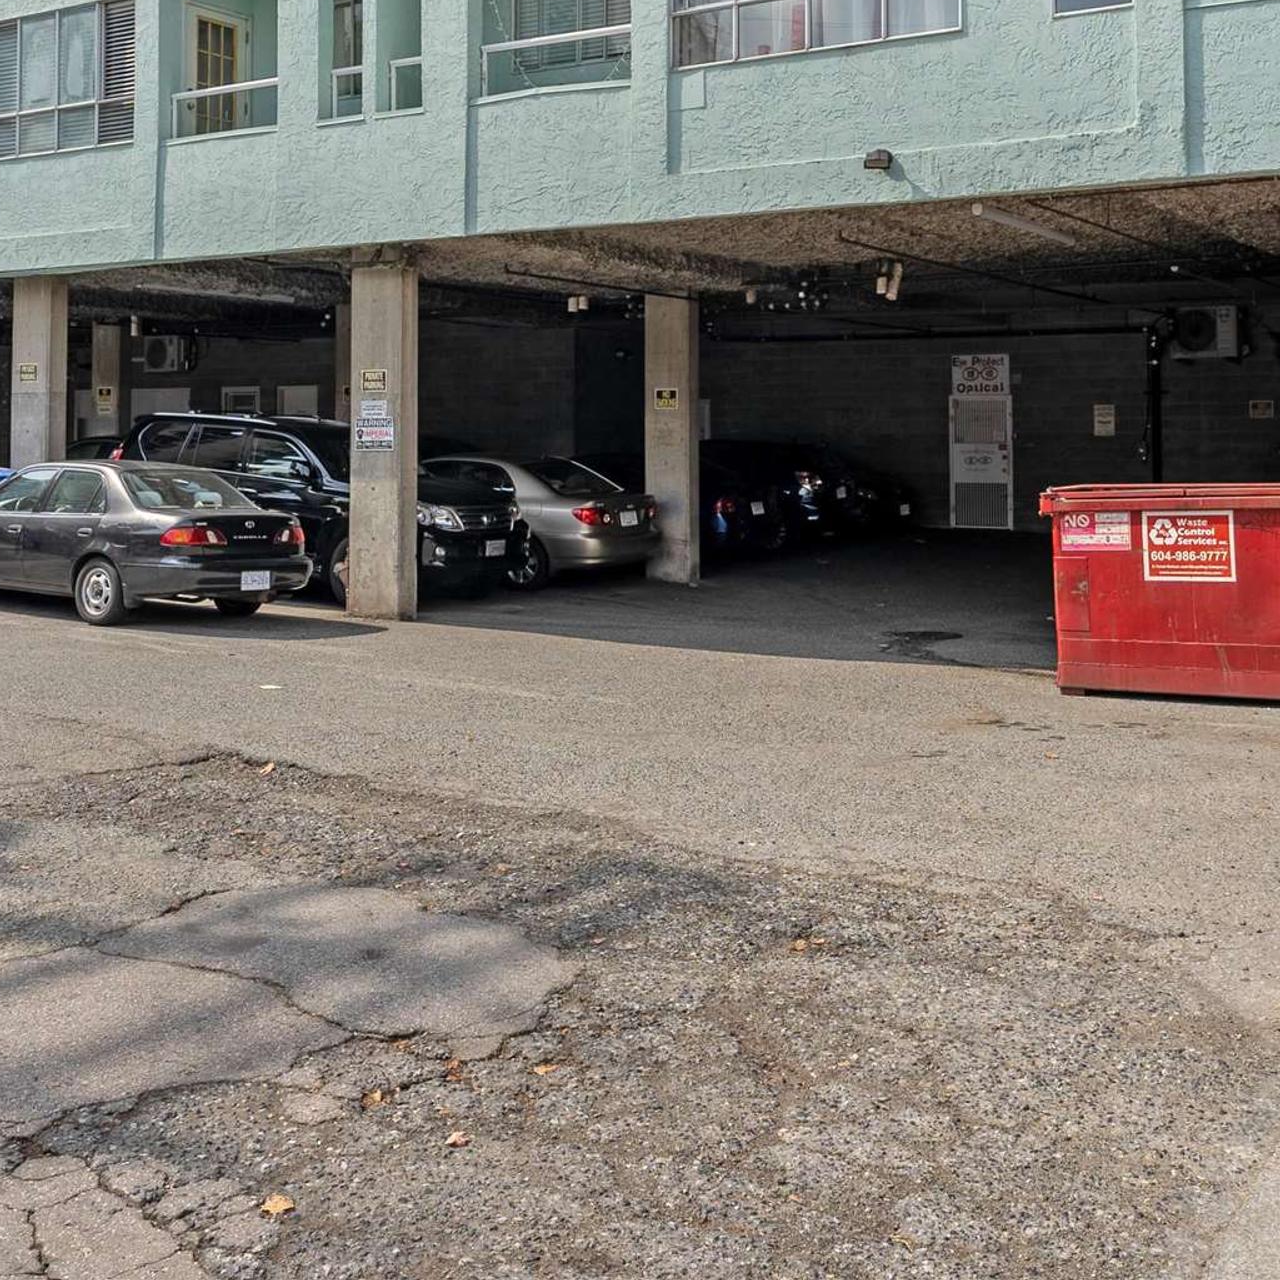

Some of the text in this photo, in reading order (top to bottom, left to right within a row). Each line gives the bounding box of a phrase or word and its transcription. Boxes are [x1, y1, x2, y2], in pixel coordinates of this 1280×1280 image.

[957, 383, 1004, 394] Optical
[1064, 514, 1090, 529] NO
[1176, 518, 1208, 527] Waste
[1177, 528, 1215, 536] Control
[1177, 537, 1217, 546] Services
[1150, 550, 1229, 562] 604-986-9777
